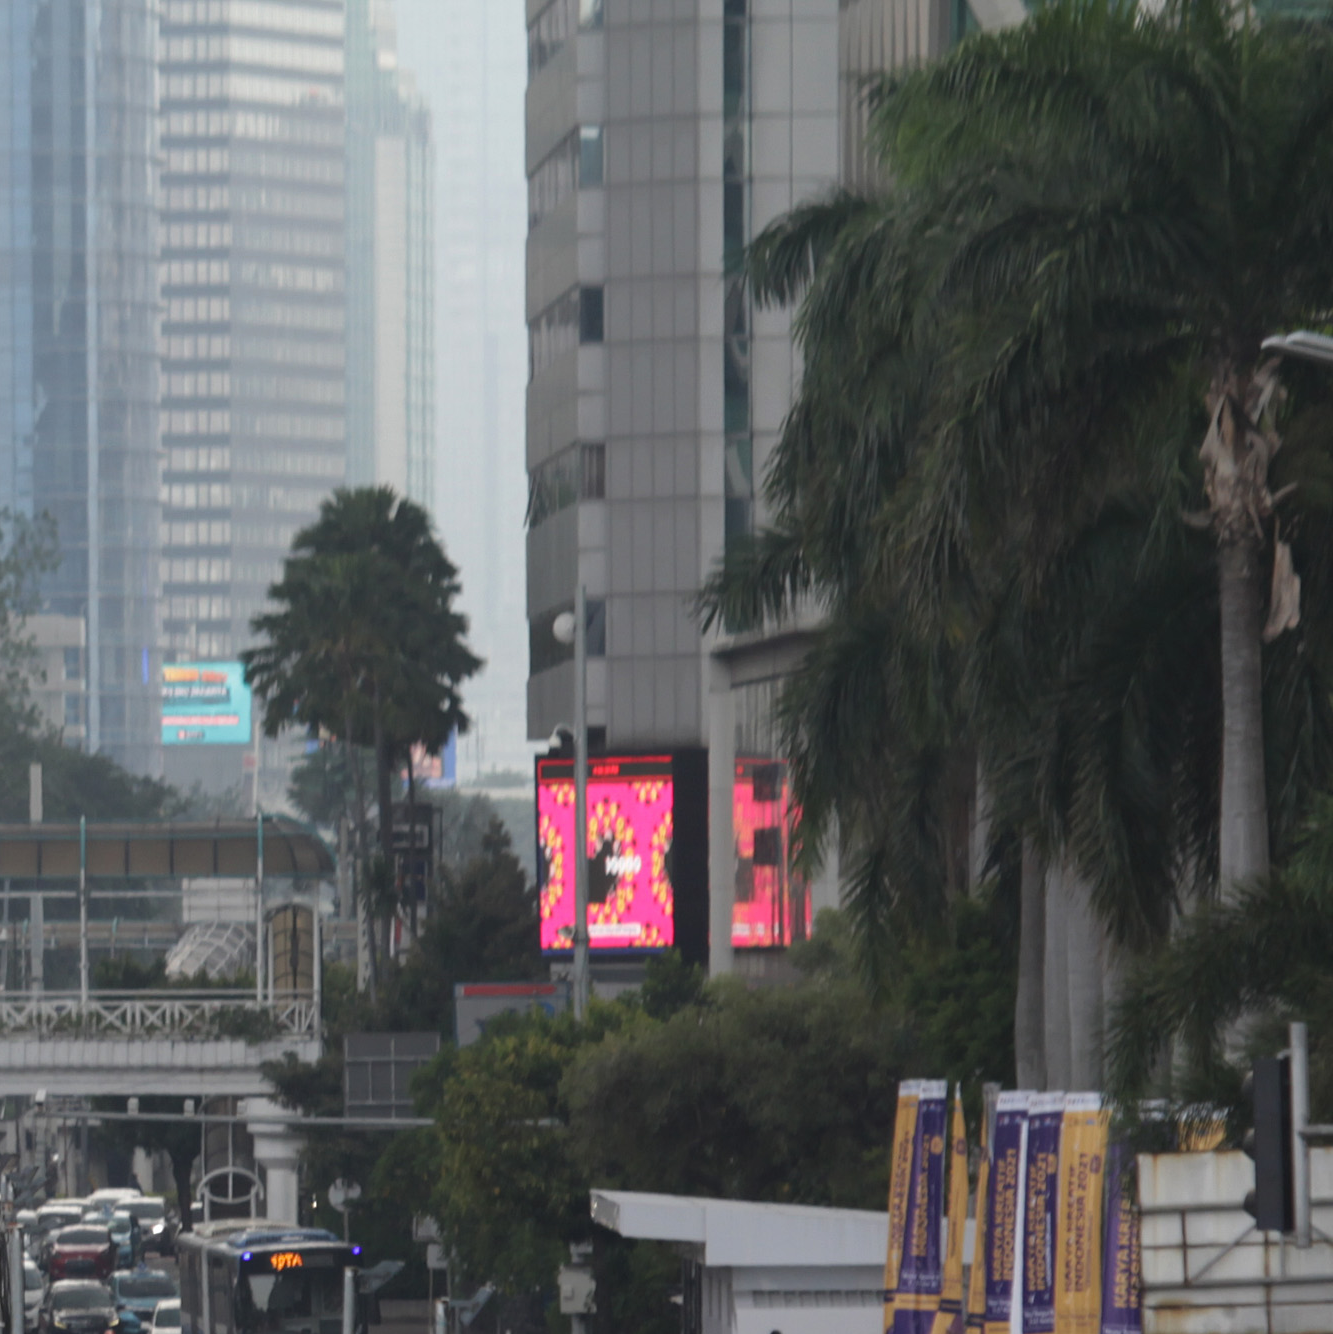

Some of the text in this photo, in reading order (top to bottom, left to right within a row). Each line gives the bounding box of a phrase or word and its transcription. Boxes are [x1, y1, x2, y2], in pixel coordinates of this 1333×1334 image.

[993, 1158, 1007, 1282] KARYA KREATIF
[1003, 1148, 1017, 1281] INDONESIA 2021
[1027, 1234, 1037, 1292] KARYA
[1036, 1152, 1048, 1292] INDONESIA 2021
[1065, 1237, 1075, 1293] KARYA
[1074, 1152, 1089, 1293] INDONESIA 2021
[1114, 1248, 1129, 1309] KARYA
